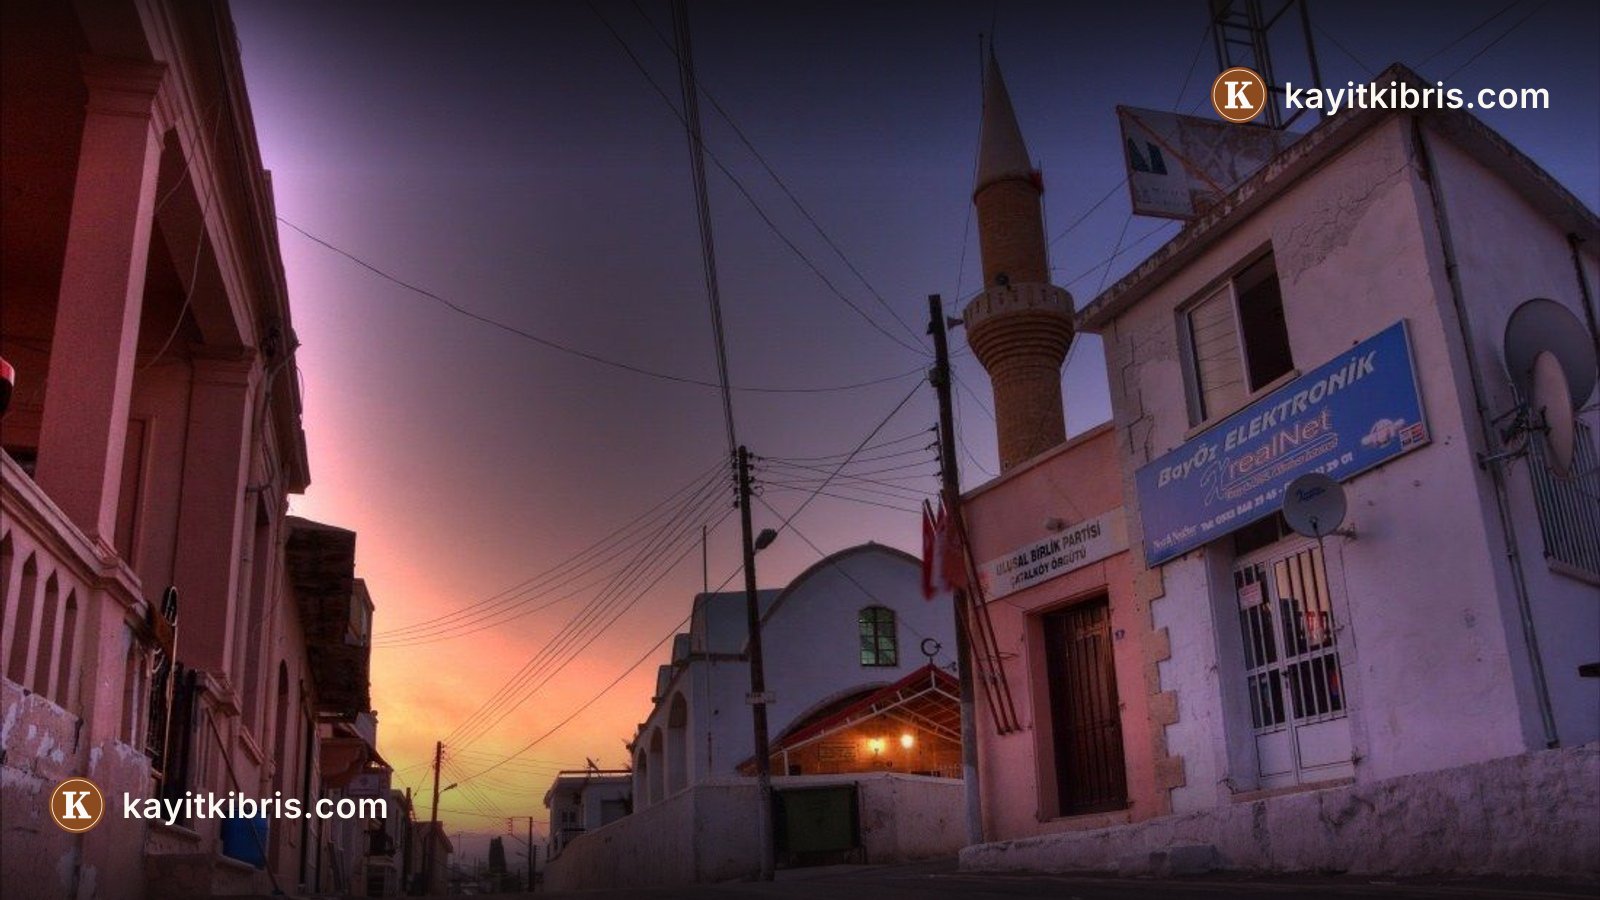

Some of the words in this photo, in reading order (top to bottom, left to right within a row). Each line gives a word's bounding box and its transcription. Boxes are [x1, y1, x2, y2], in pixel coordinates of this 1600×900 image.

[1224, 350, 1377, 452] ELEKTRONİK
[996, 554, 1029, 576] ULUSAL
[1031, 539, 1061, 562] BİRLİK
[1063, 521, 1101, 549] PARTİSİ
